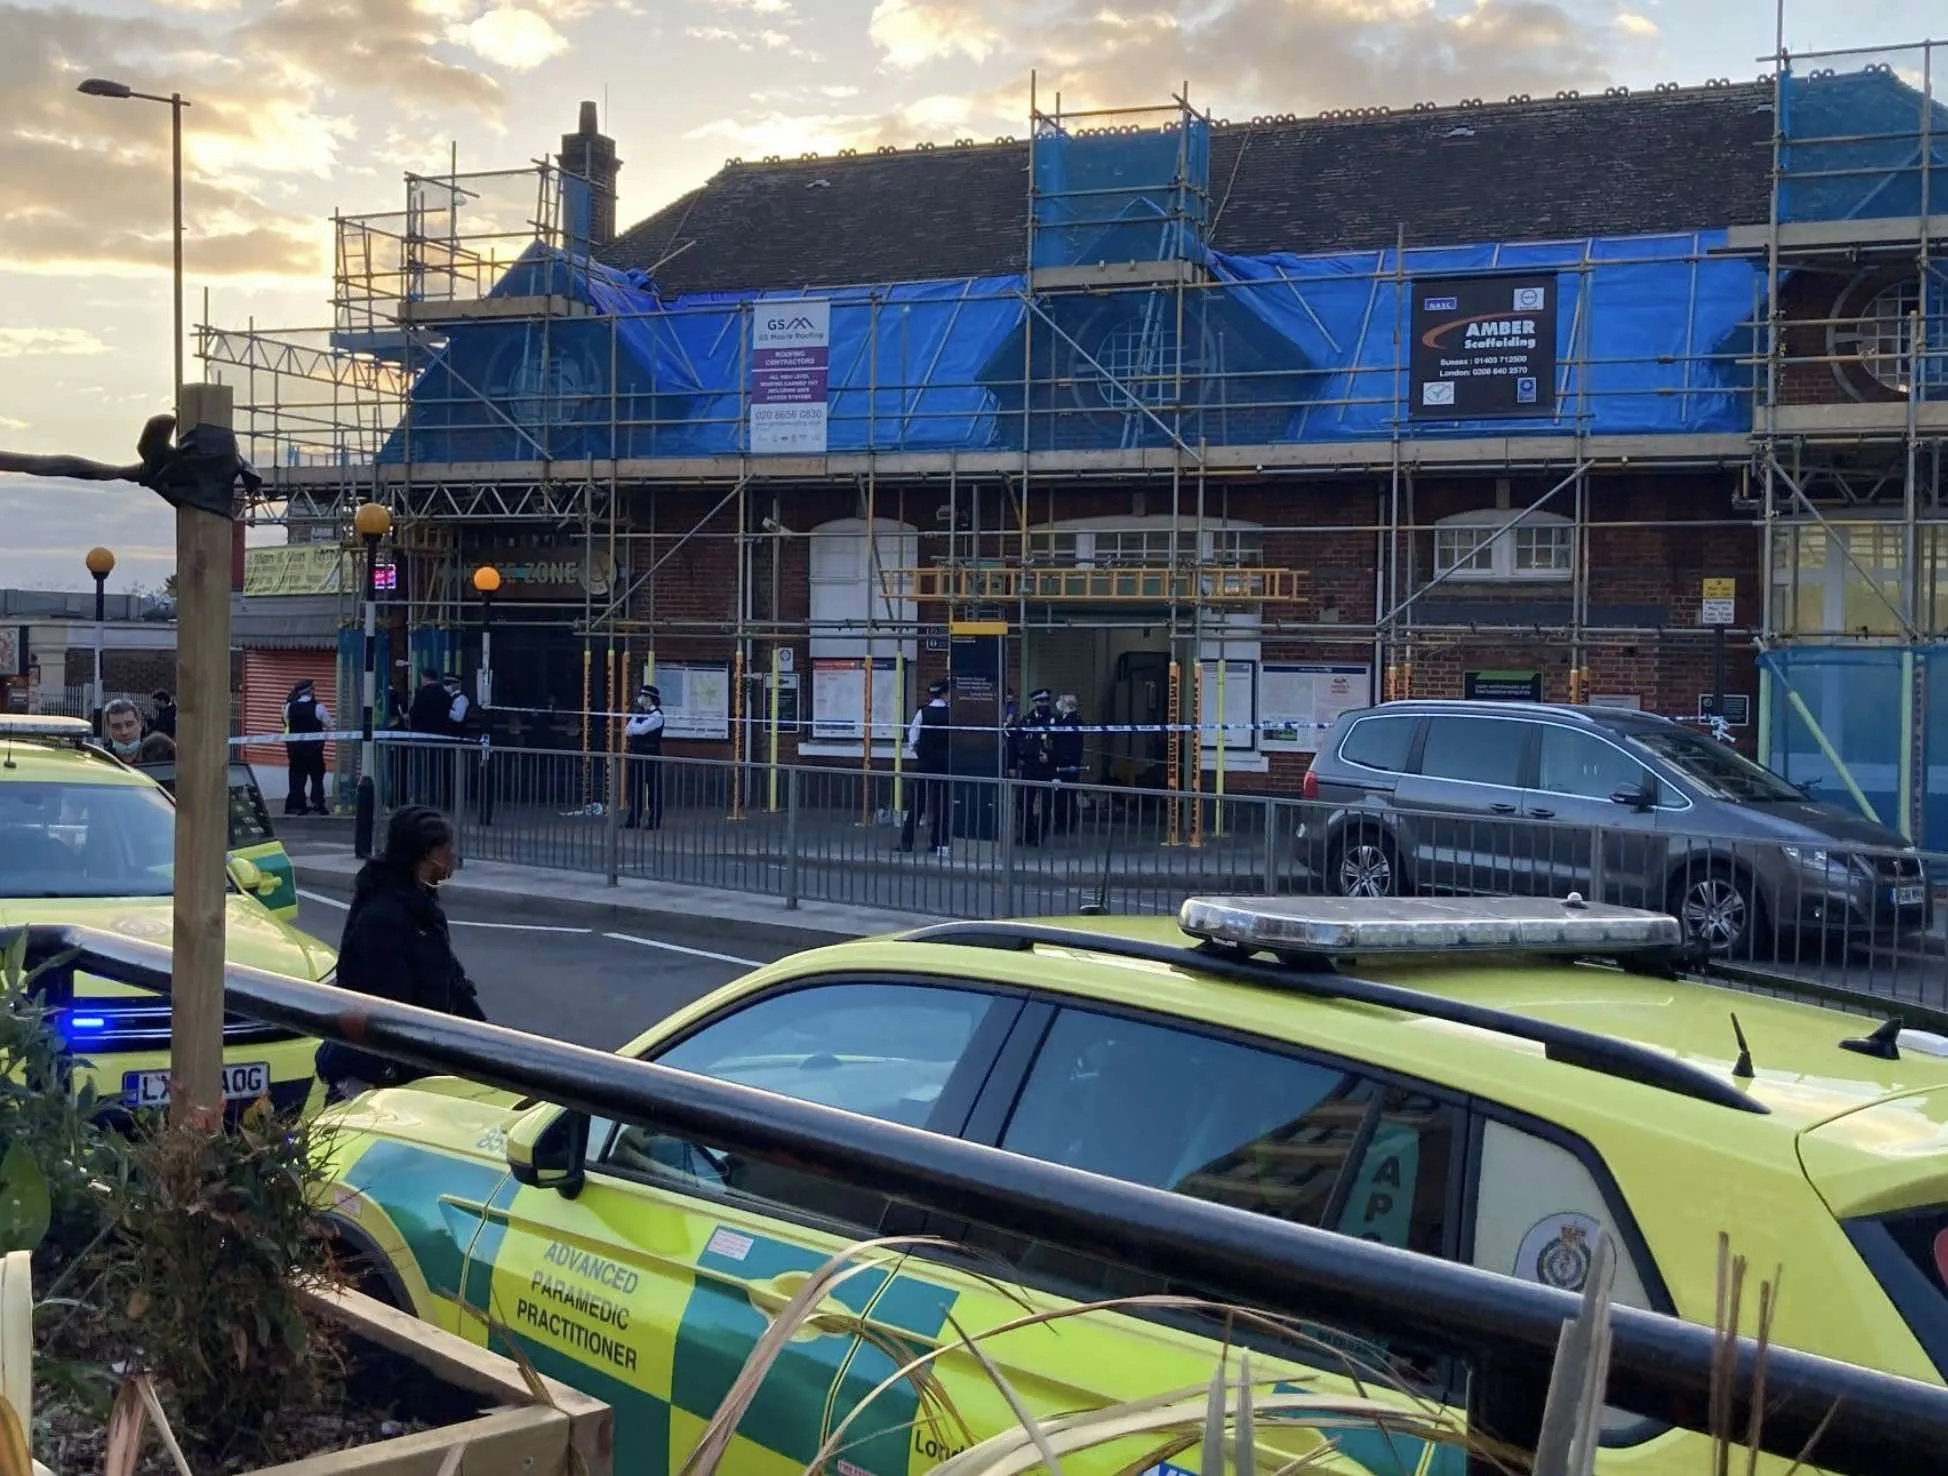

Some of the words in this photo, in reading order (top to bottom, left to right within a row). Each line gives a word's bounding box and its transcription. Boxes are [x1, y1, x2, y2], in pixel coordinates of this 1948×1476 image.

[1465, 320, 1535, 337] AMBER
[1464, 337, 1536, 349] Scaffolding
[765, 358, 815, 367] CONTRACTORS
[1440, 369, 1471, 378] London:
[525, 561, 577, 584] ZONE
[543, 1240, 640, 1295] ADVANCED
[530, 1270, 630, 1331] PARAMEDIC
[517, 1298, 638, 1373] PRACTITIONER
